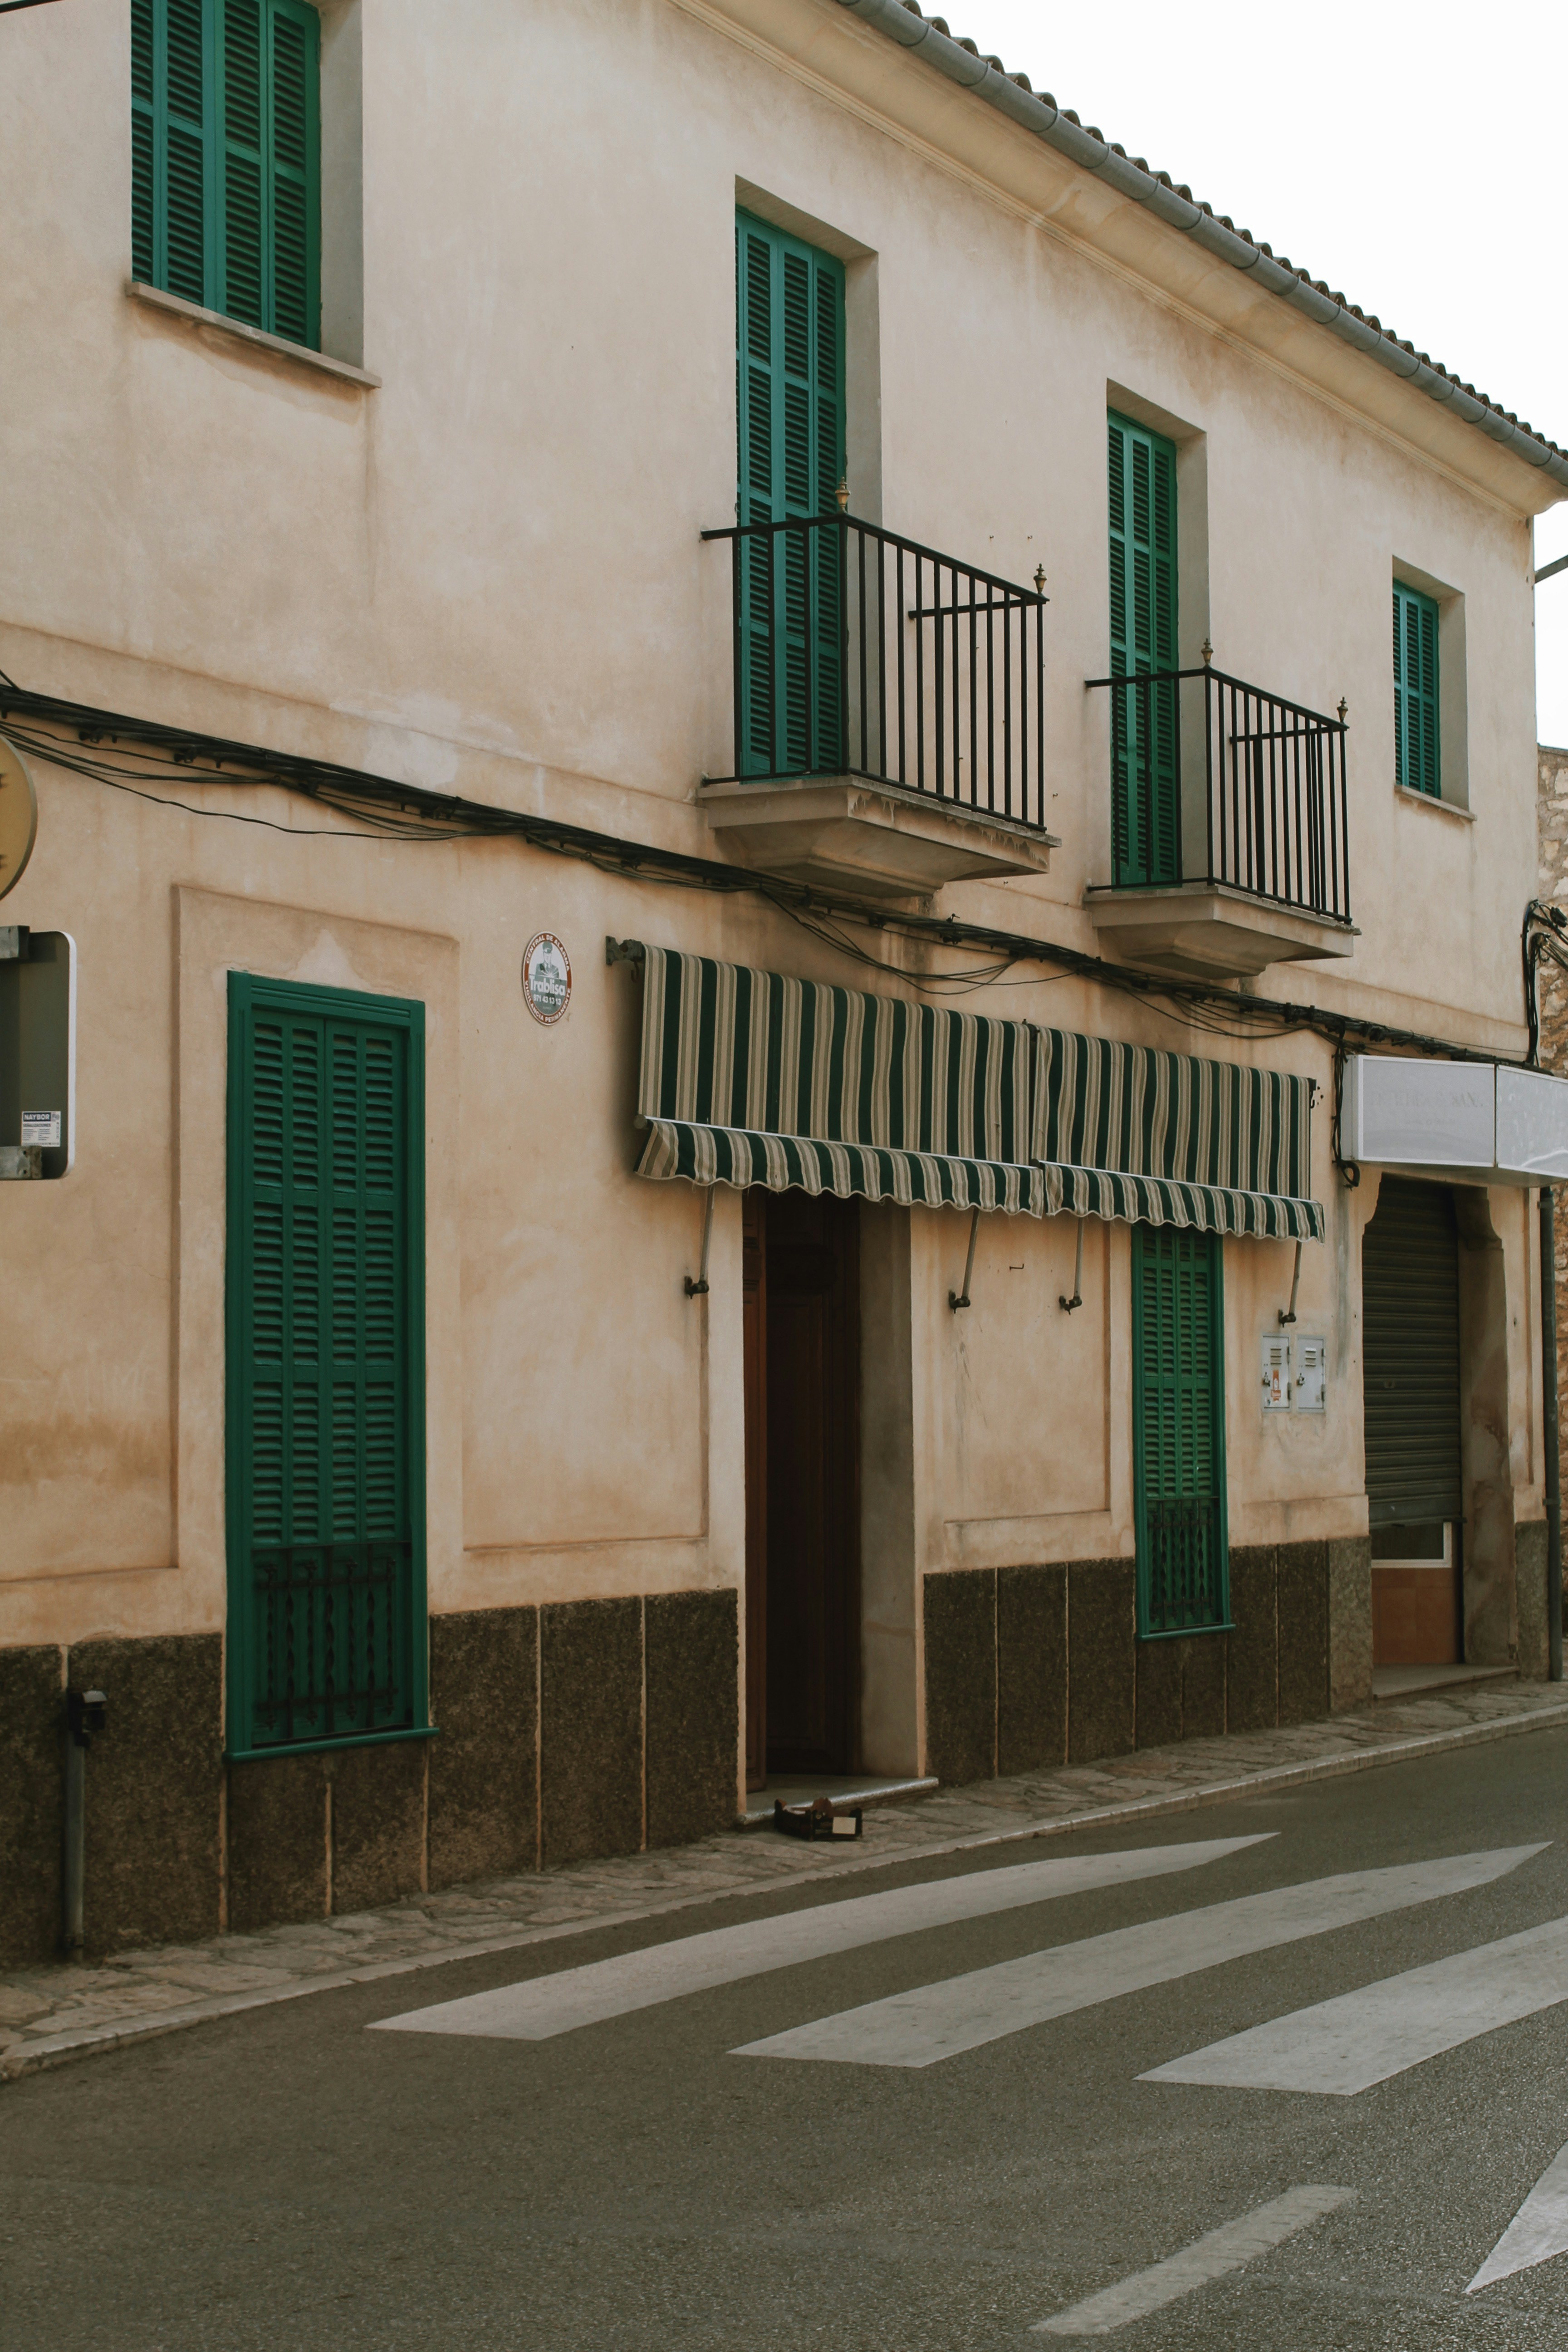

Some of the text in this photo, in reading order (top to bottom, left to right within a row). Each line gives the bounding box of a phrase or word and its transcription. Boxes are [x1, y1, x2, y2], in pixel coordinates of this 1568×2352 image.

[526, 935, 545, 964] CENTRAL
[554, 939, 569, 971] ALARMA
[525, 980, 571, 1022] VIGILANCIA PERMANENTE
[529, 975, 565, 996] Trablisa
